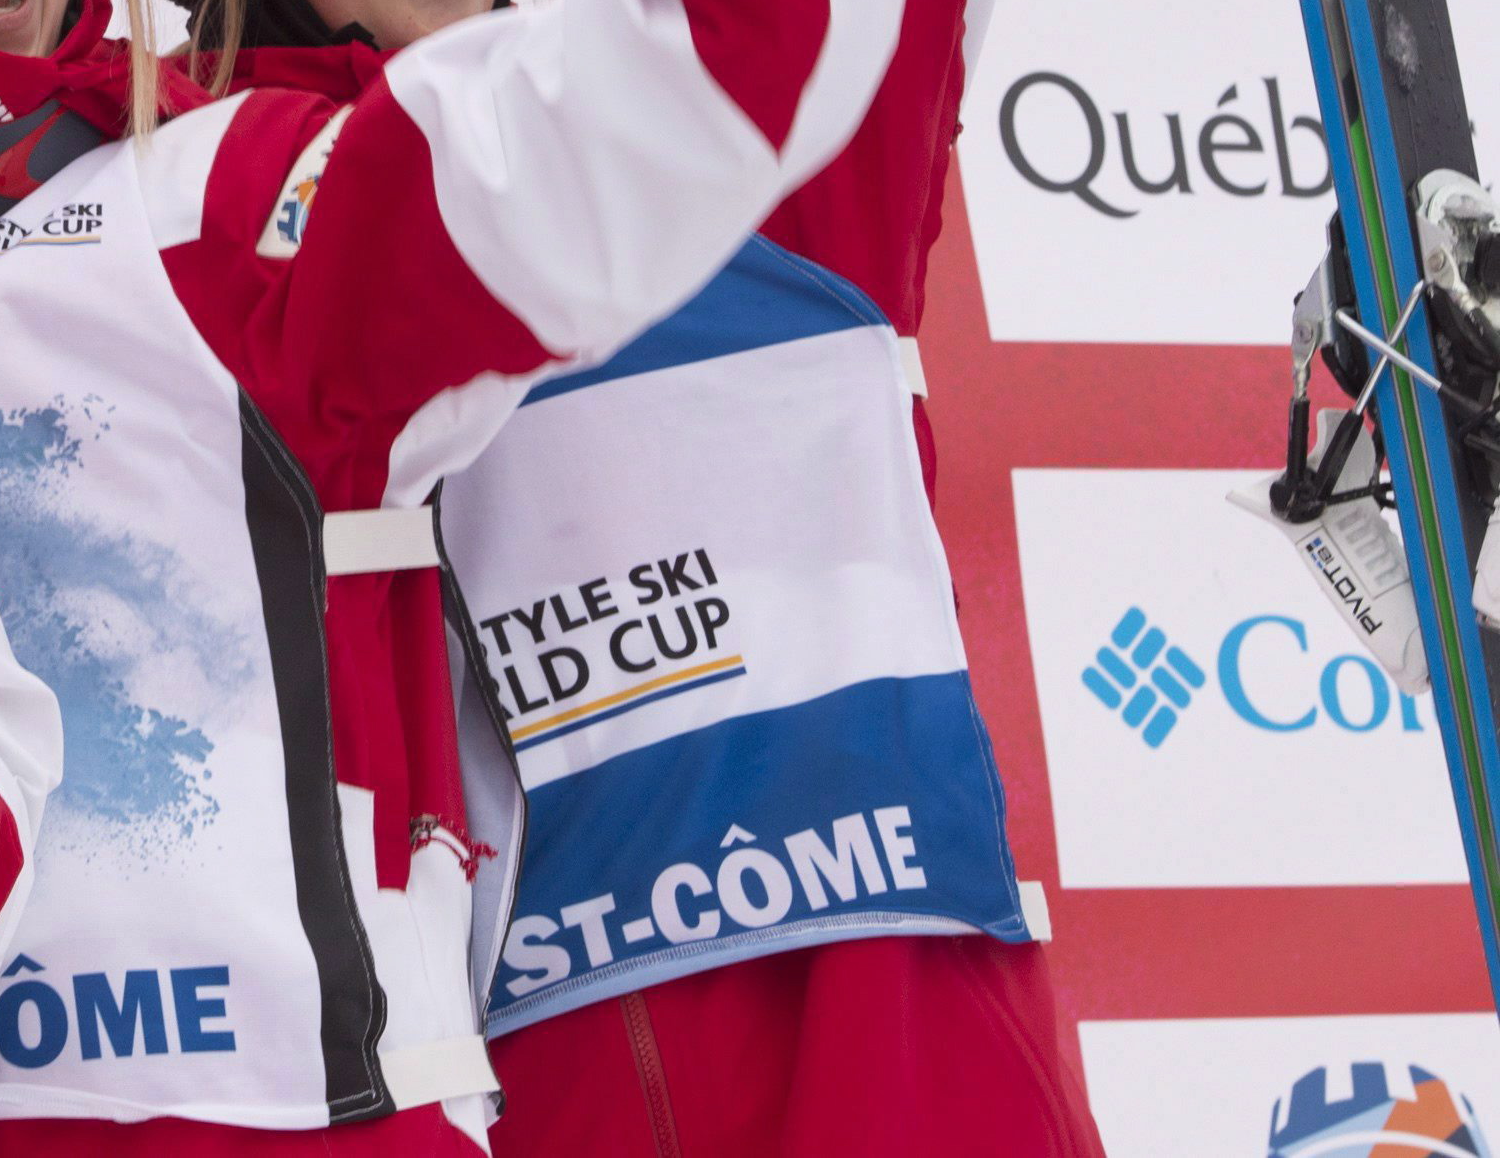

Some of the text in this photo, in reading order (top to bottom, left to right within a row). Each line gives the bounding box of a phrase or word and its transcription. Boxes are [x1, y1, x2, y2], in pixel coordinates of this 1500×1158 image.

[999, 71, 1333, 219] Québ
[42, 219, 103, 236] CUP
[62, 203, 103, 217] SKI
[478, 548, 719, 657] TYLE SKI
[609, 597, 730, 673] CUP
[502, 805, 928, 999] ST-CÔME
